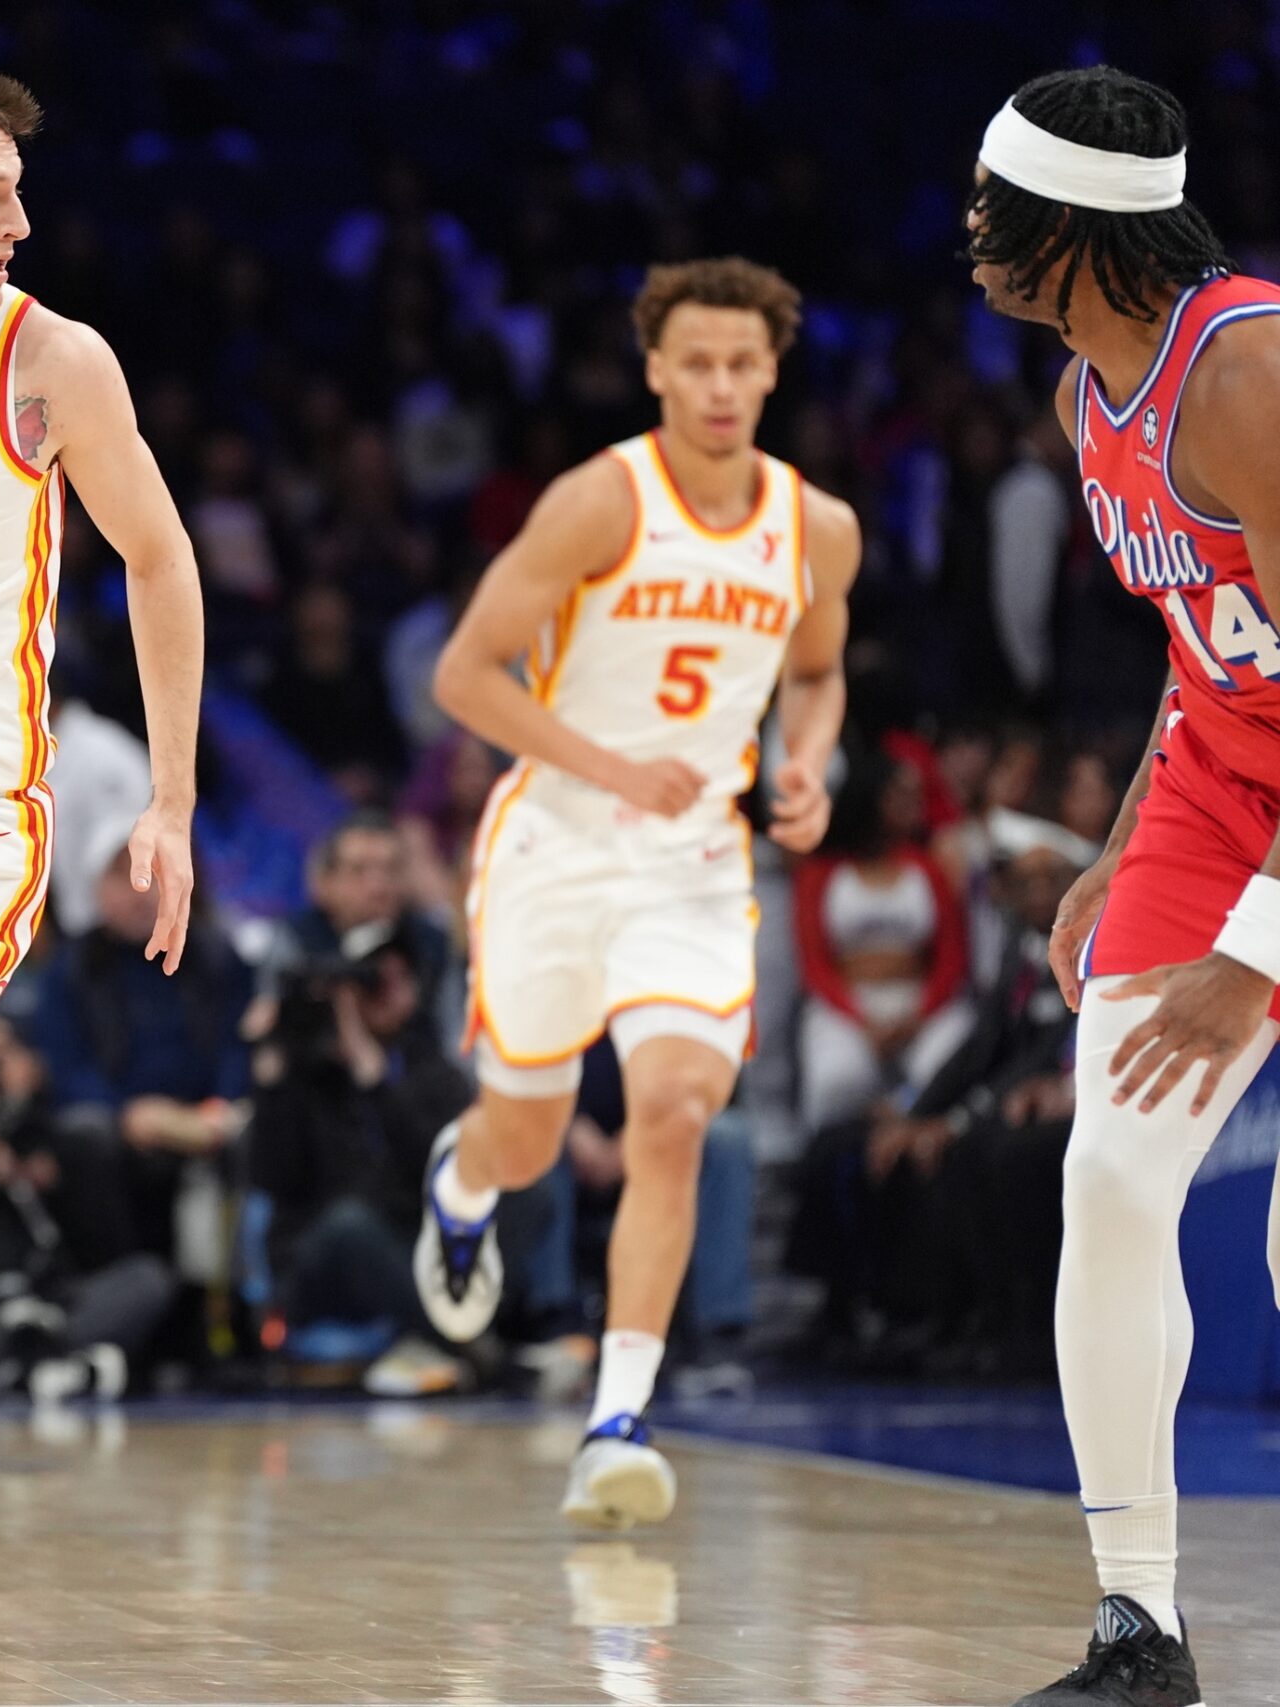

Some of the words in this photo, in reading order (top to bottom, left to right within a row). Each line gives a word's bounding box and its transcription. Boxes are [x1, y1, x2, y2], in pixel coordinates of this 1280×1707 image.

[1082, 477, 1214, 589] Phila
[610, 580, 788, 638] ATLANTA
[1164, 582, 1280, 691] 14
[655, 646, 721, 720] 5
